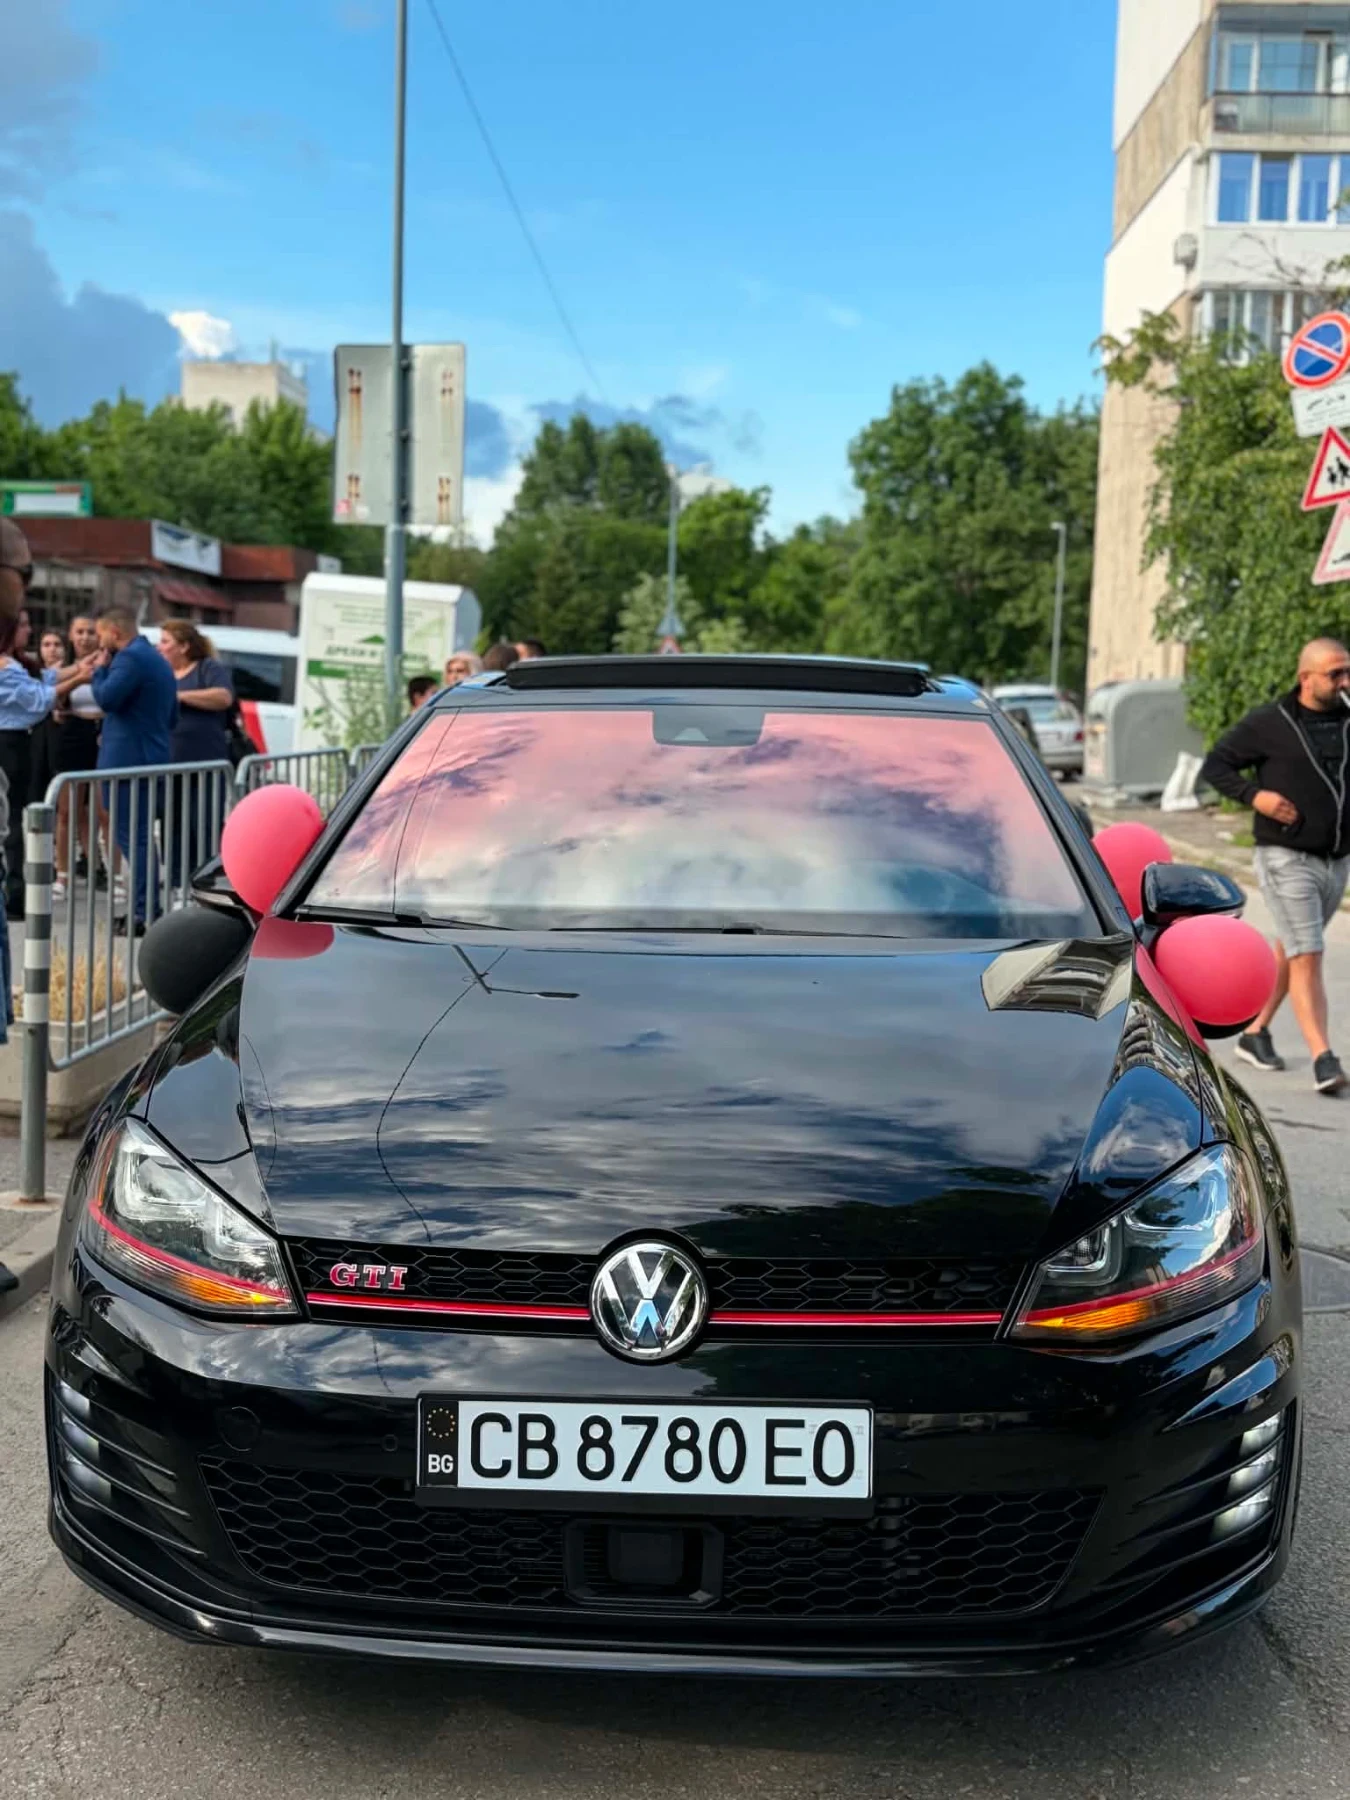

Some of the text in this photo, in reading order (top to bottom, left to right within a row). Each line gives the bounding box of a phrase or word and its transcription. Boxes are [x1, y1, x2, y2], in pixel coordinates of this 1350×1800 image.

[330, 1263, 408, 1290] GTI
[470, 1412, 559, 1479] CB
[577, 1415, 747, 1484] 8780
[428, 1454, 454, 1474] BG
